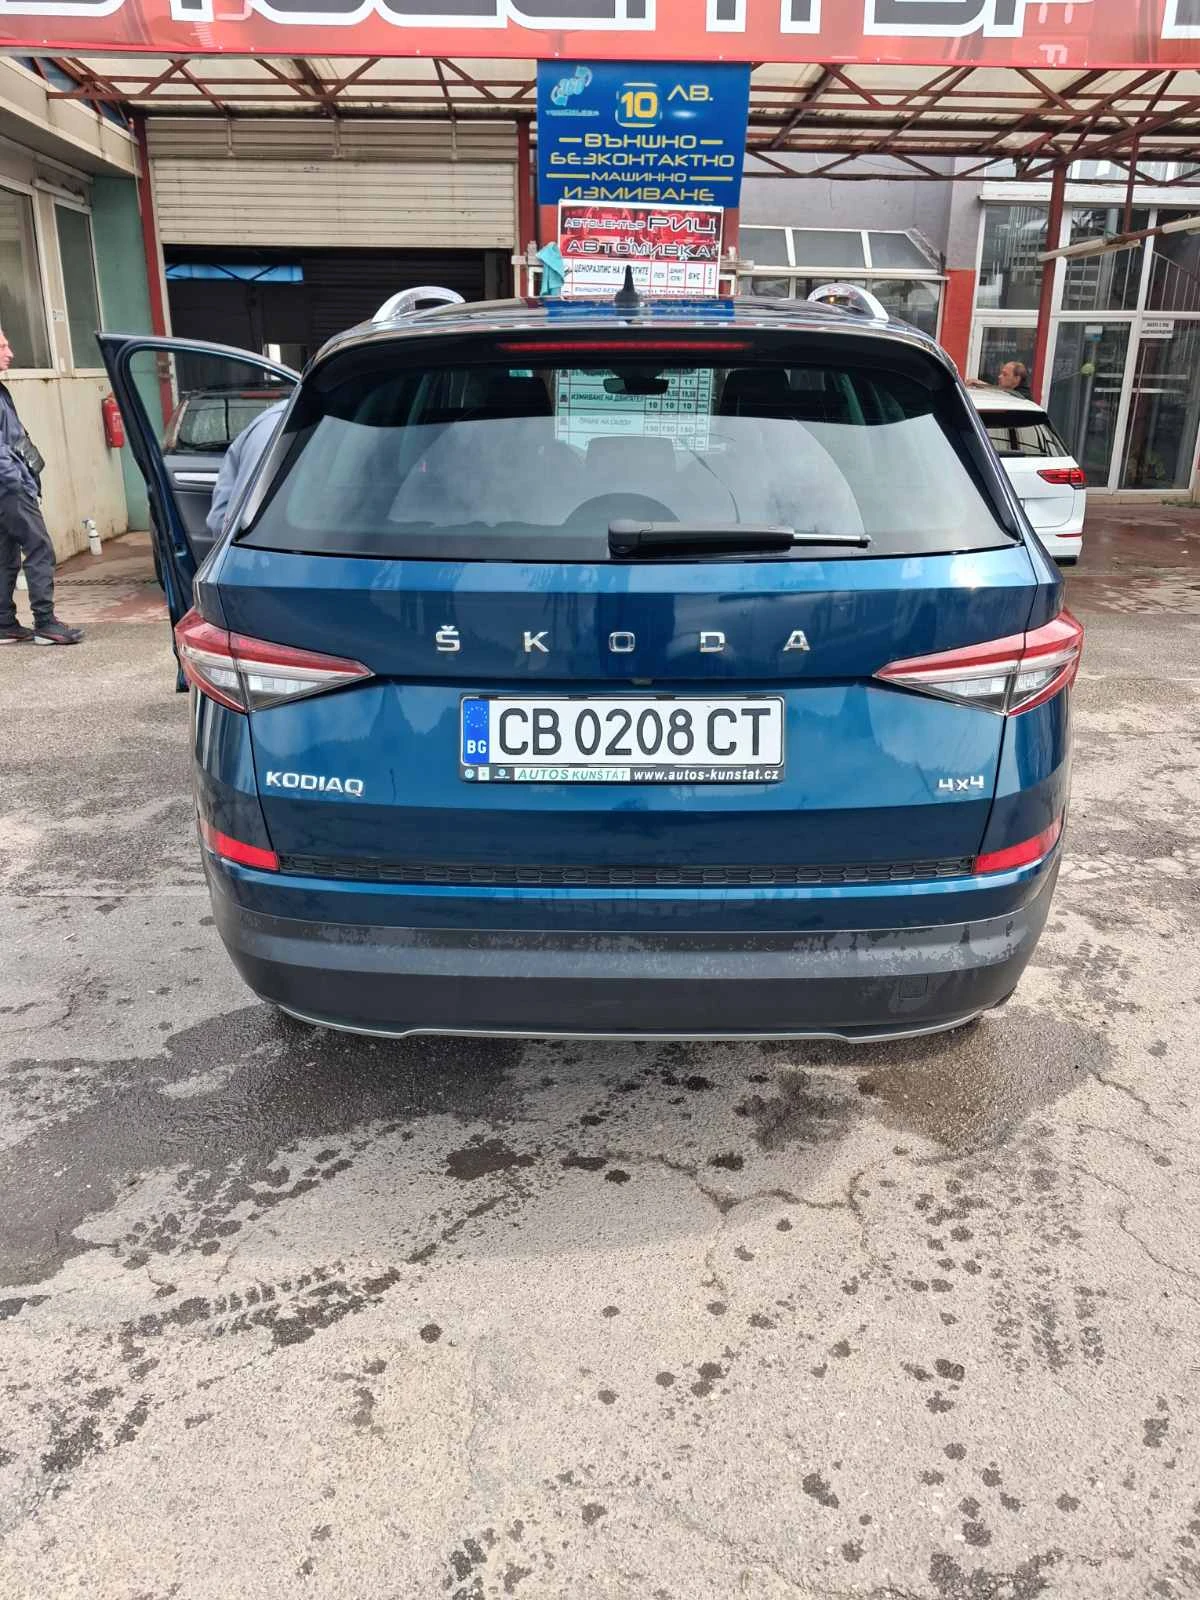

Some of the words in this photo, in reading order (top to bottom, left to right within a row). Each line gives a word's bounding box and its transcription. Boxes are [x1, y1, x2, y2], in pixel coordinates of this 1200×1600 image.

[620, 91, 658, 118] 10
[584, 133, 697, 149] ВЪНШНО
[550, 152, 735, 168] БЕЗКОНТАКТНО
[591, 171, 687, 182] МАШИННО
[564, 186, 715, 201] ИЗМИВАНЕ
[565, 218, 646, 231] АВТОЦЕНТЪР
[648, 215, 716, 234] РИЦ
[567, 240, 711, 258] АВТОМИВКА
[435, 625, 811, 653] ŠKODA
[499, 708, 562, 756] CB
[575, 708, 694, 756] 0208
[707, 708, 771, 756] CT
[466, 740, 487, 754] BG
[518, 769, 569, 780] AUTOS
[634, 768, 779, 781] www.autos-kunstat.cz
[266, 771, 364, 797] KODIAQ
[939, 775, 985, 791] 4x4
